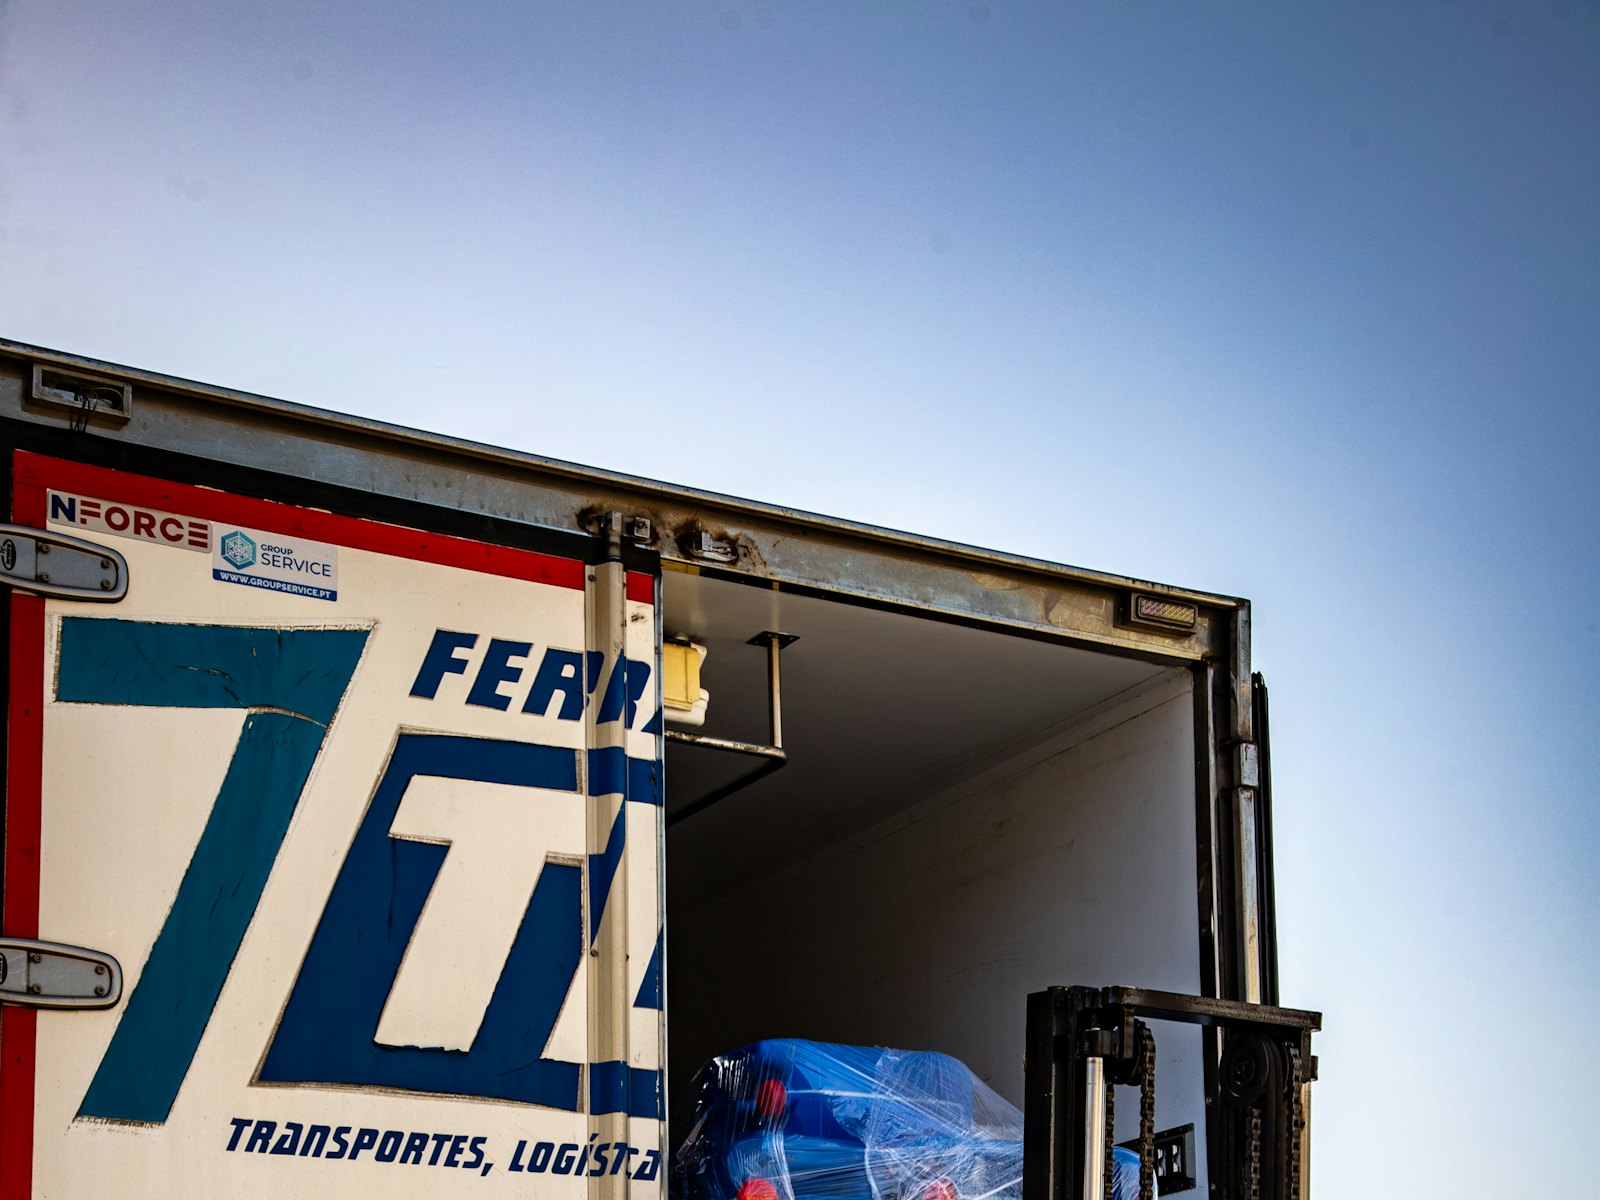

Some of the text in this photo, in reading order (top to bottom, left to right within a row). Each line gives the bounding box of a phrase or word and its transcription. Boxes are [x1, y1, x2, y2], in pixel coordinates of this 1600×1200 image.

[51, 493, 209, 549] NFORCE
[260, 543, 293, 556] GROUP
[260, 553, 332, 578] SERVICE
[219, 571, 331, 599] WWW.GROUPSERVICE.PT
[226, 1117, 494, 1177] TRANSPORTES,
